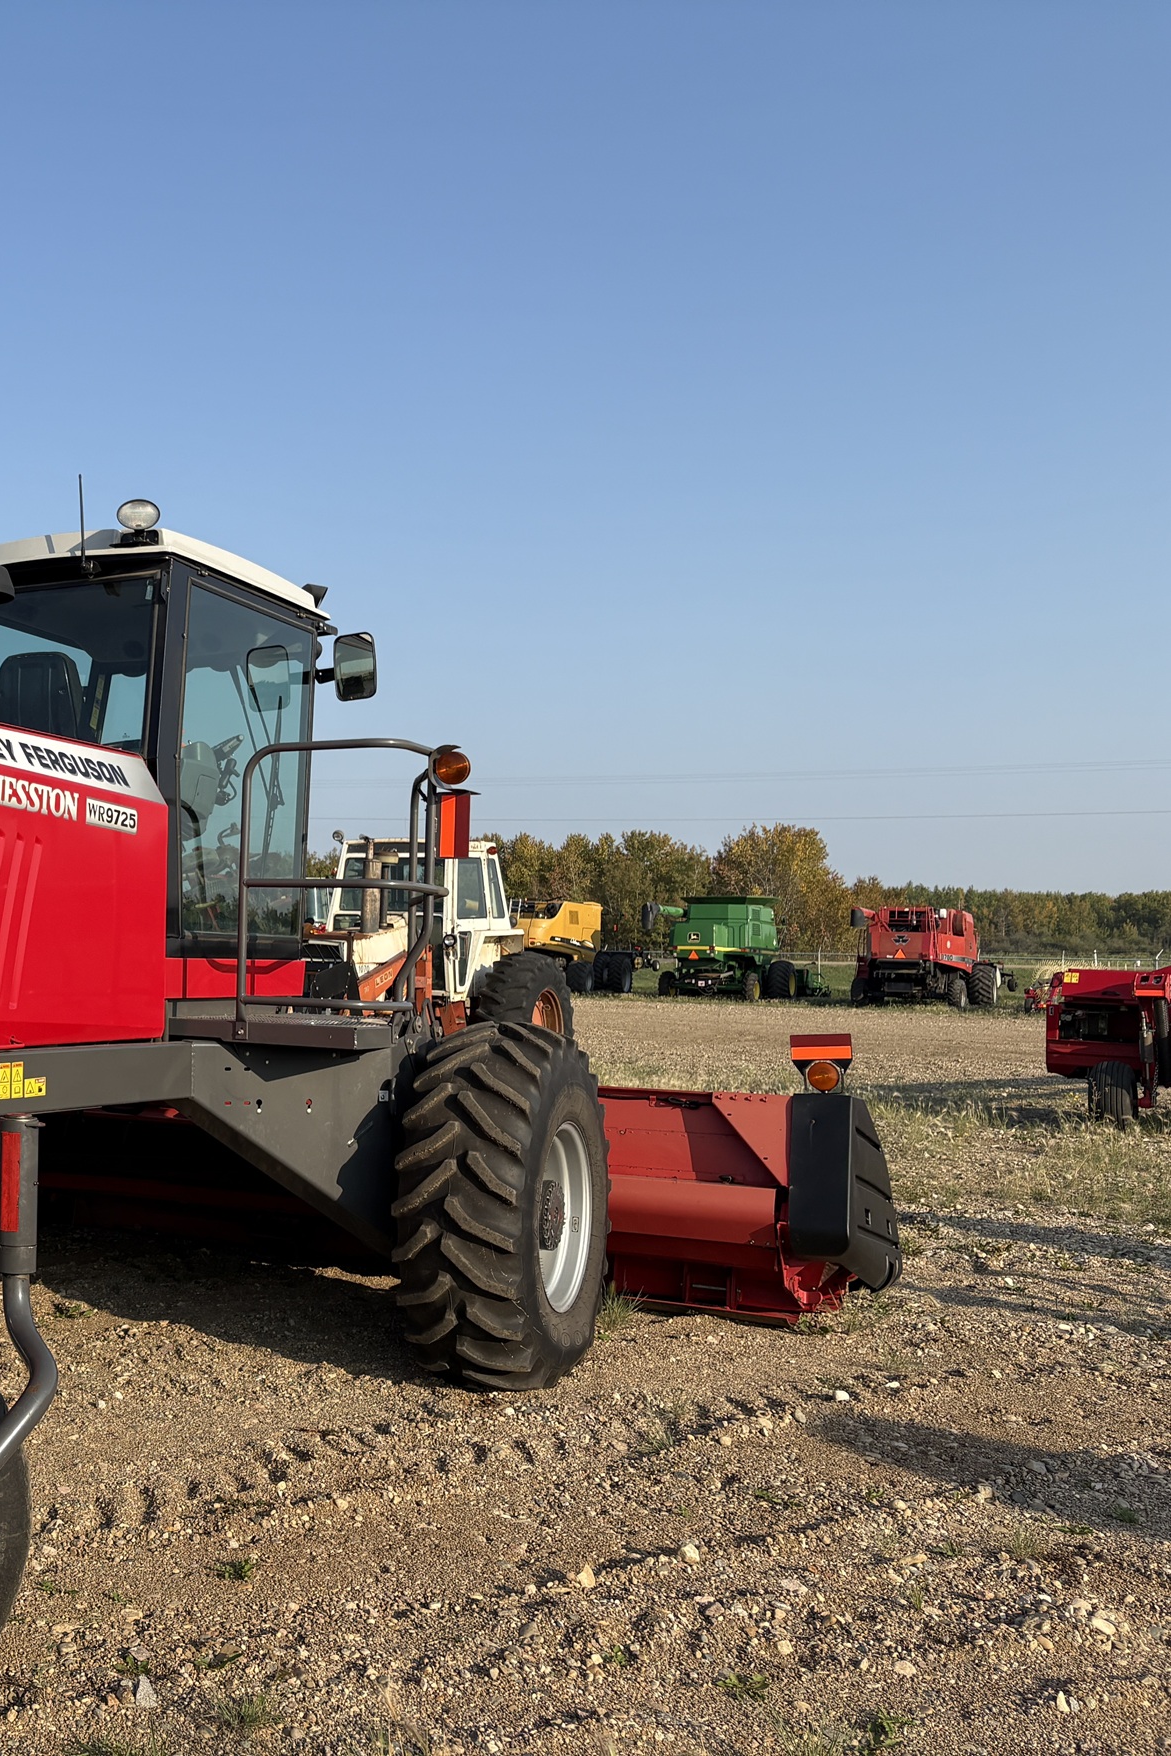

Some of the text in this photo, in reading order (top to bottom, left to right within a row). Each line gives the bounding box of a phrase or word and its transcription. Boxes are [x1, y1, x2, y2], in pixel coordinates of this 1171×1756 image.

[18, 741, 131, 788] FERGUSON
[87, 802, 137, 829] WR9725
[375, 970, 393, 986] LEON
